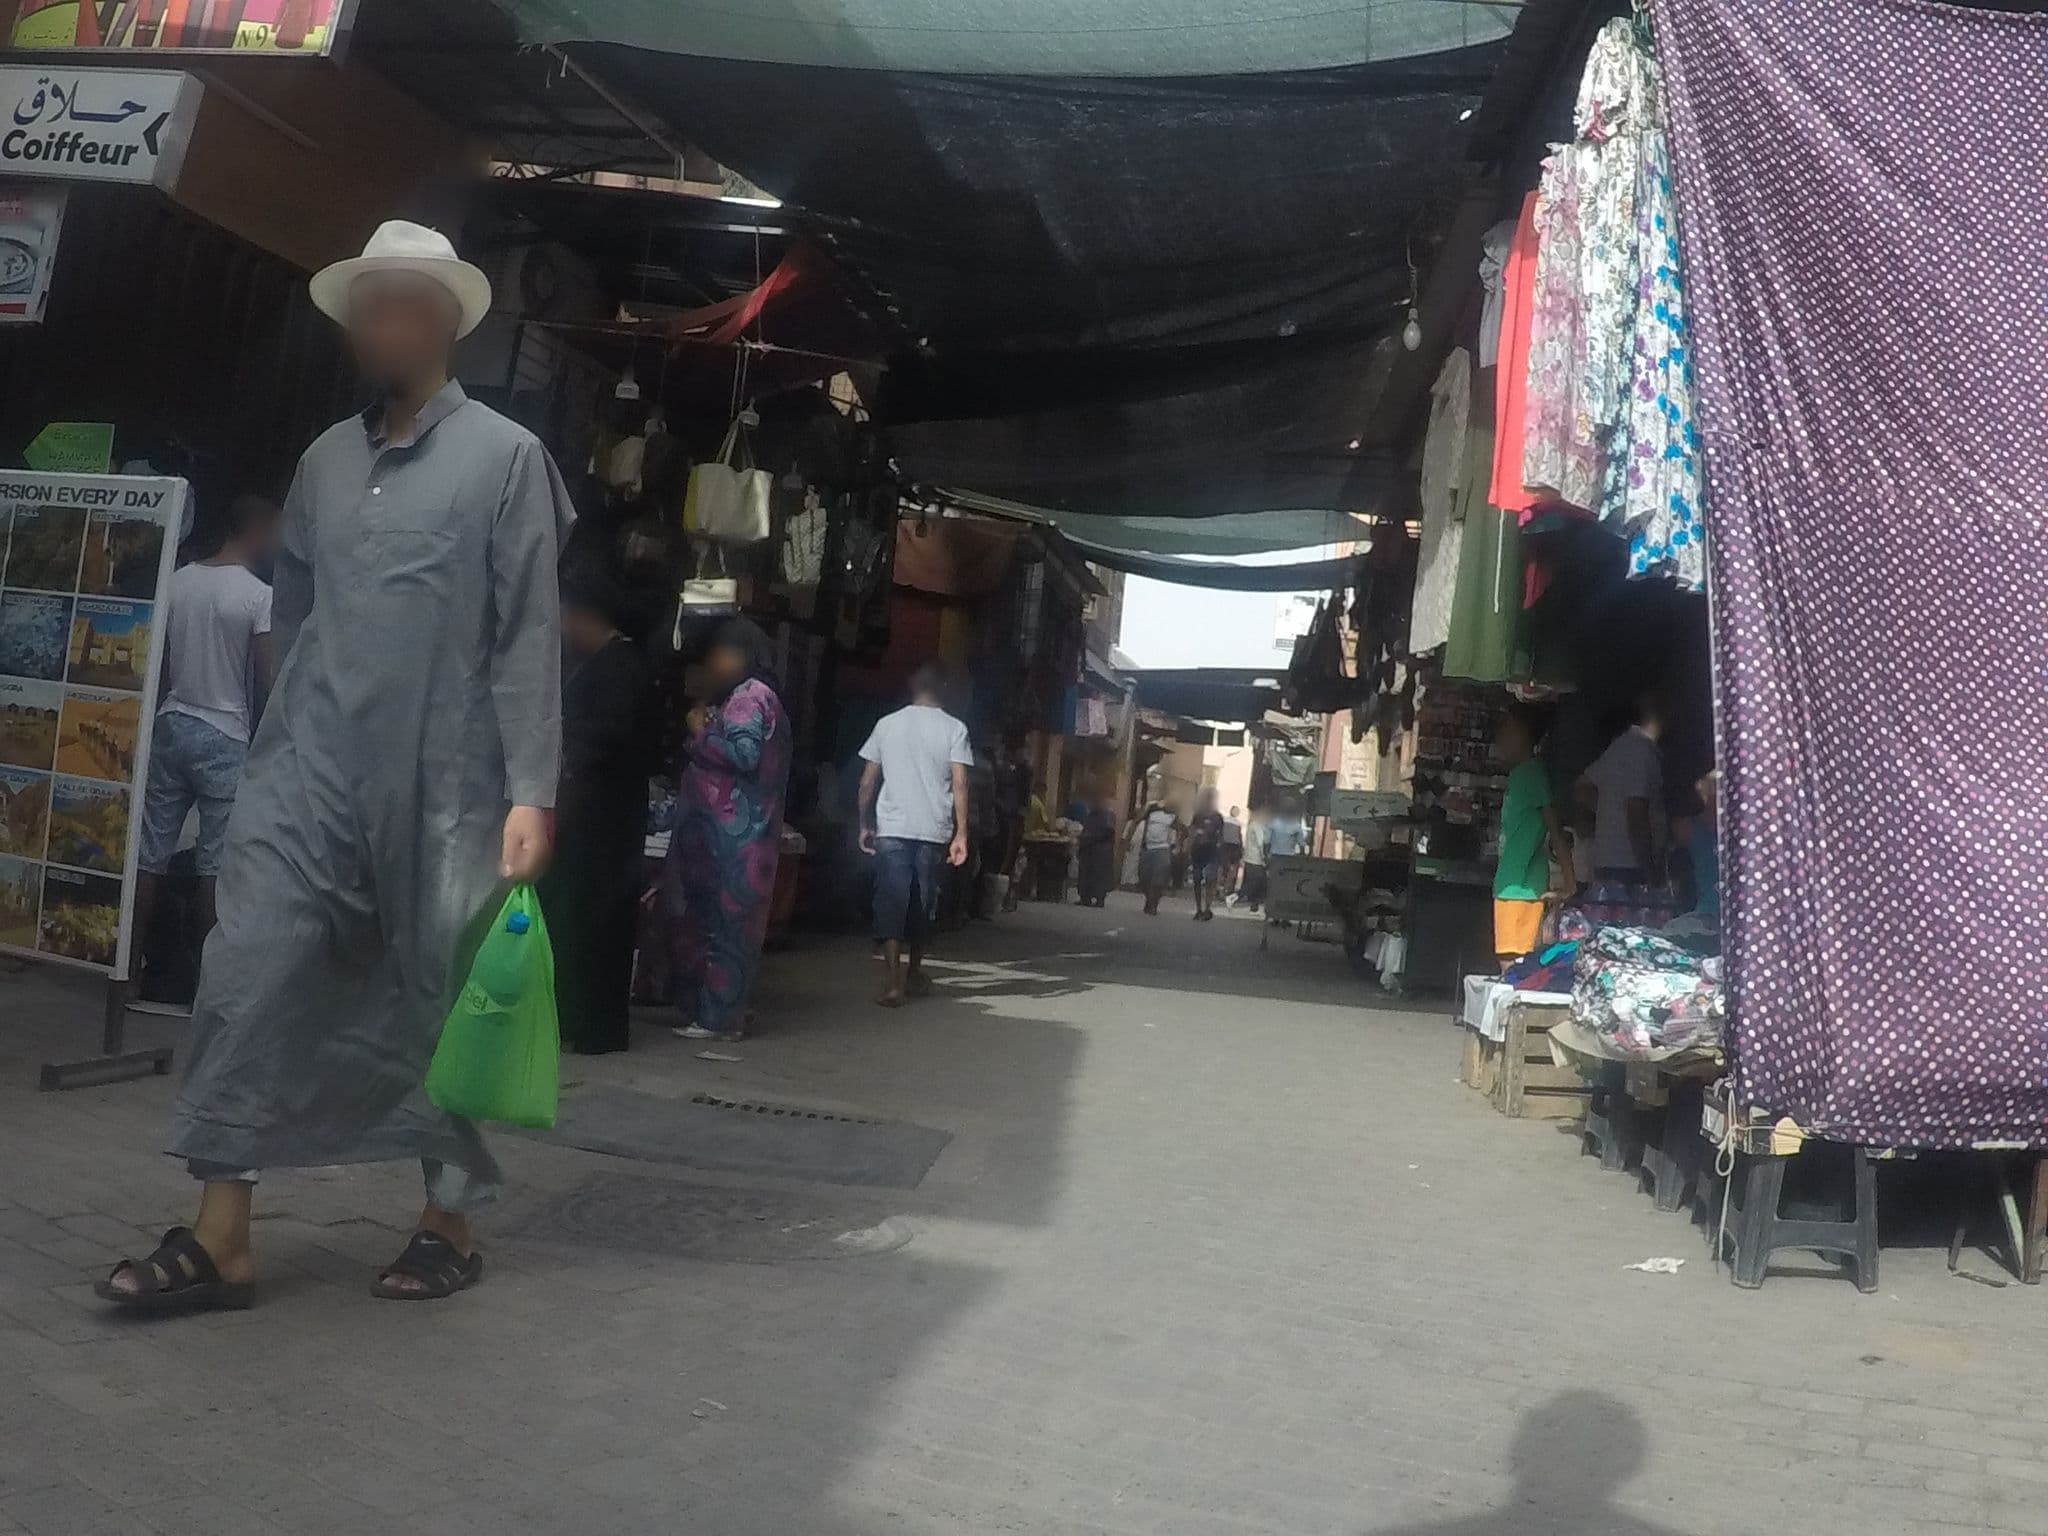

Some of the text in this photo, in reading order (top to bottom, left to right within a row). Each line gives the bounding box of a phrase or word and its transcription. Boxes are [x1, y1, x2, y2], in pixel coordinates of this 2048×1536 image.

[13, 77, 147, 125] حلاق
[1, 129, 139, 166] Coiffeur
[57, 486, 119, 506] EVERY
[124, 490, 166, 508] DAY
